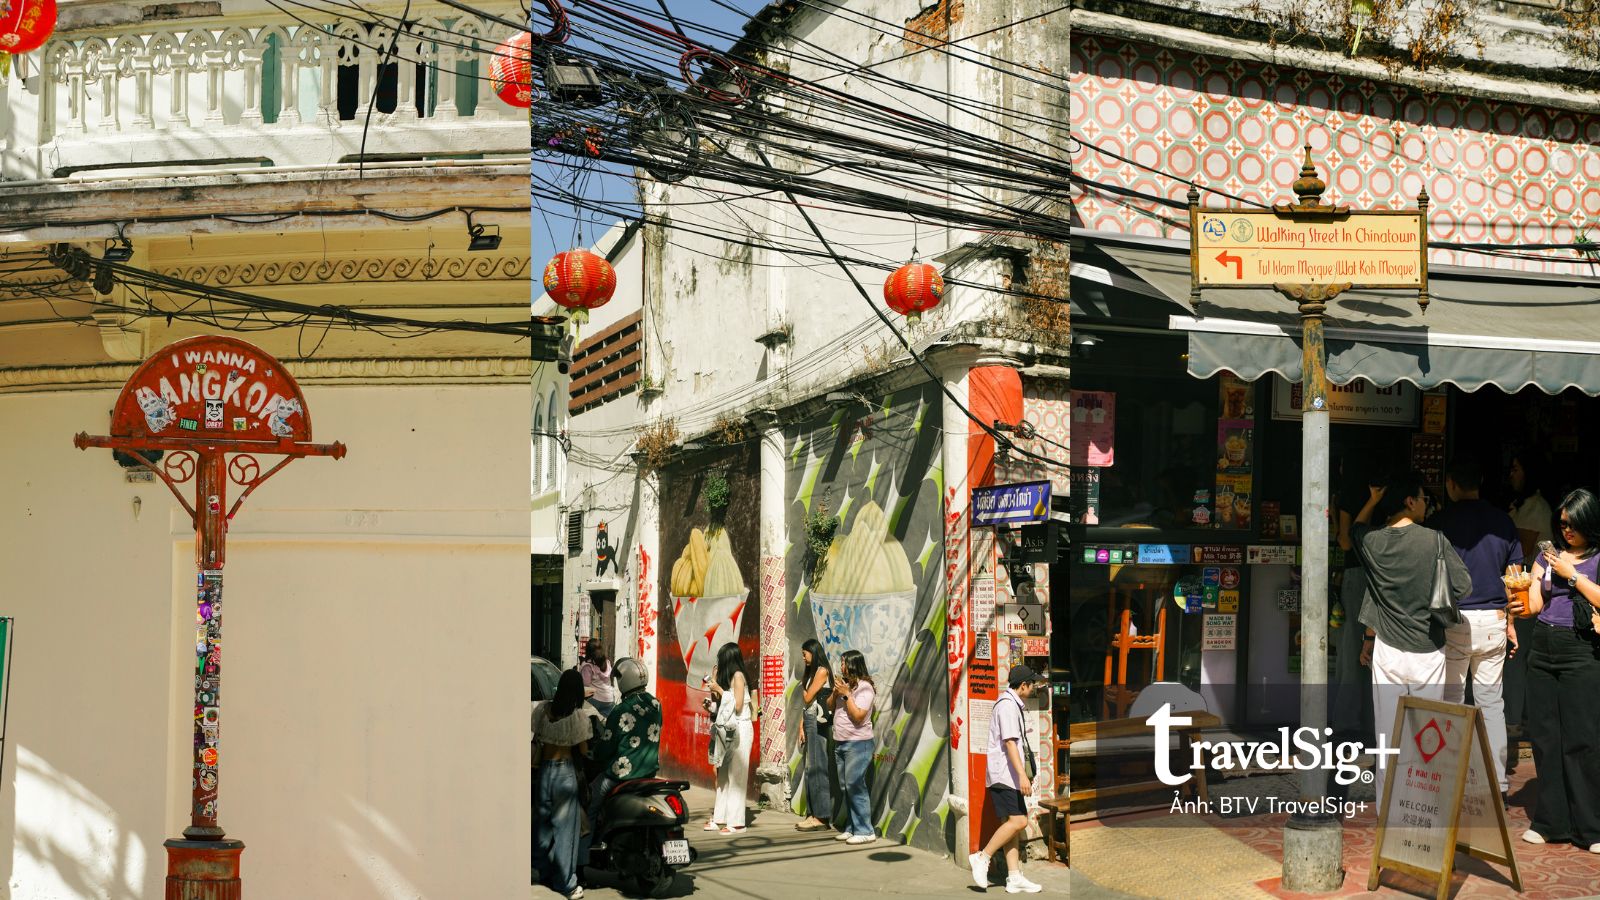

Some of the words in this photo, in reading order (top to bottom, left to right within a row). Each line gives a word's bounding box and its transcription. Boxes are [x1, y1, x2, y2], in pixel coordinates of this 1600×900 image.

[1257, 227, 1305, 247] Walking
[1309, 227, 1338, 243] Street
[1343, 227, 1352, 243] In
[1356, 227, 1417, 243] Chinatown
[1273, 260, 1295, 276] Islam
[1298, 260, 1333, 279] Mosque
[1335, 260, 1356, 276] (Wat
[1360, 260, 1376, 276] Koh
[1379, 260, 1417, 279] Mosque)
[172, 353, 180, 368] I
[185, 350, 256, 374] WANNA
[1380, 406, 1393, 414] 100
[1399, 799, 1439, 816] WELCOME
